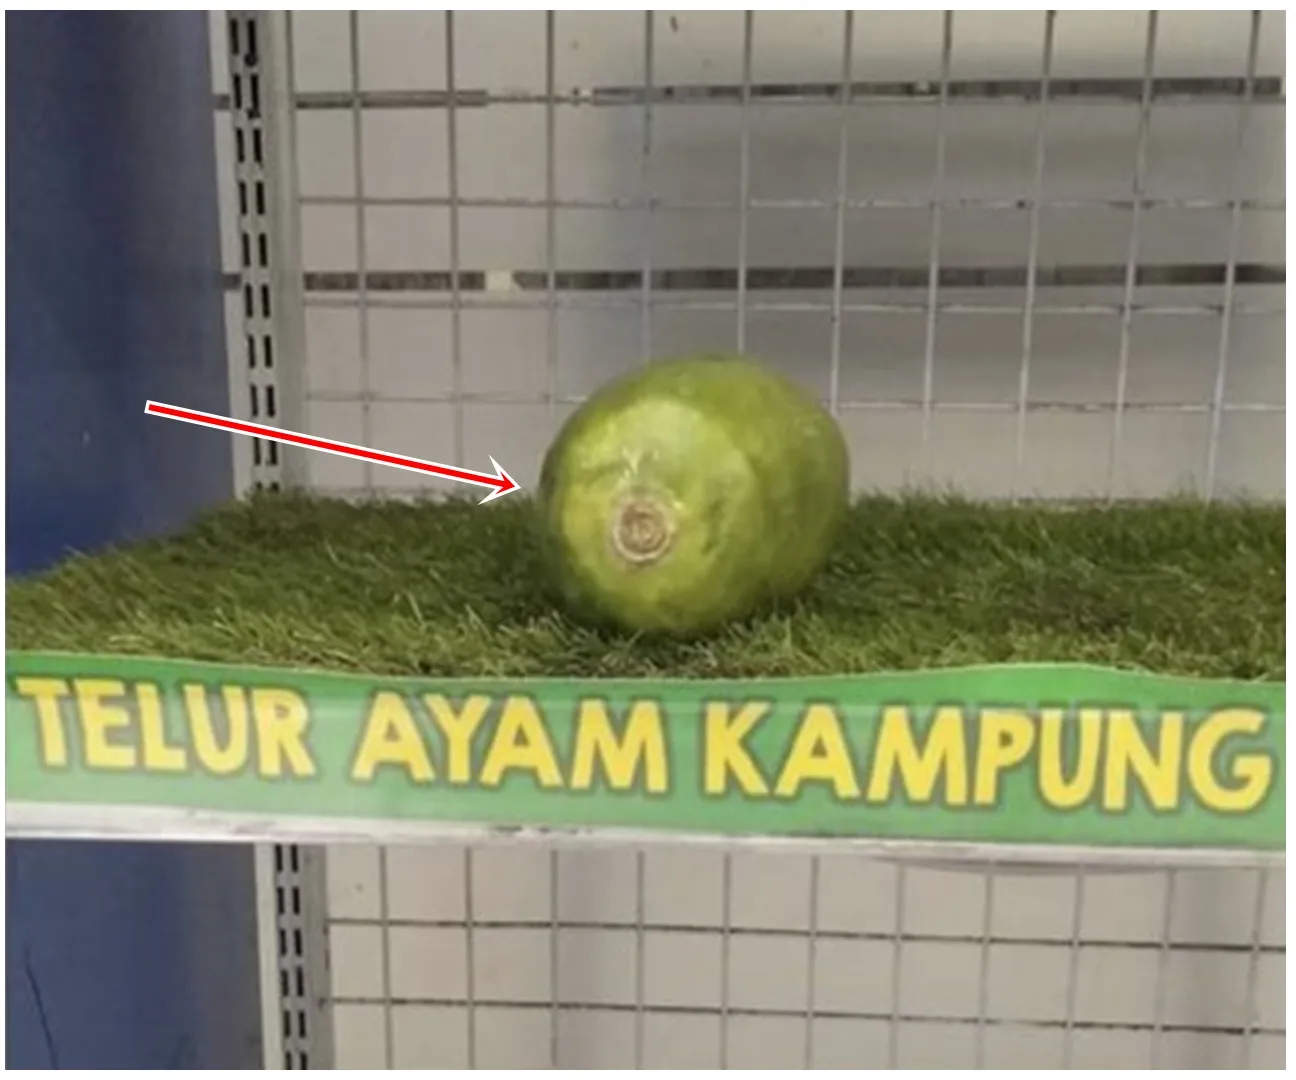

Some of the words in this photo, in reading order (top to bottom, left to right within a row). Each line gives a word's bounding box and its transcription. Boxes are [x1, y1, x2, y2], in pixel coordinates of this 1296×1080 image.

[16, 676, 316, 778] TELUR
[350, 692, 669, 794] AYAM
[705, 700, 1272, 812] KAMPUNG
